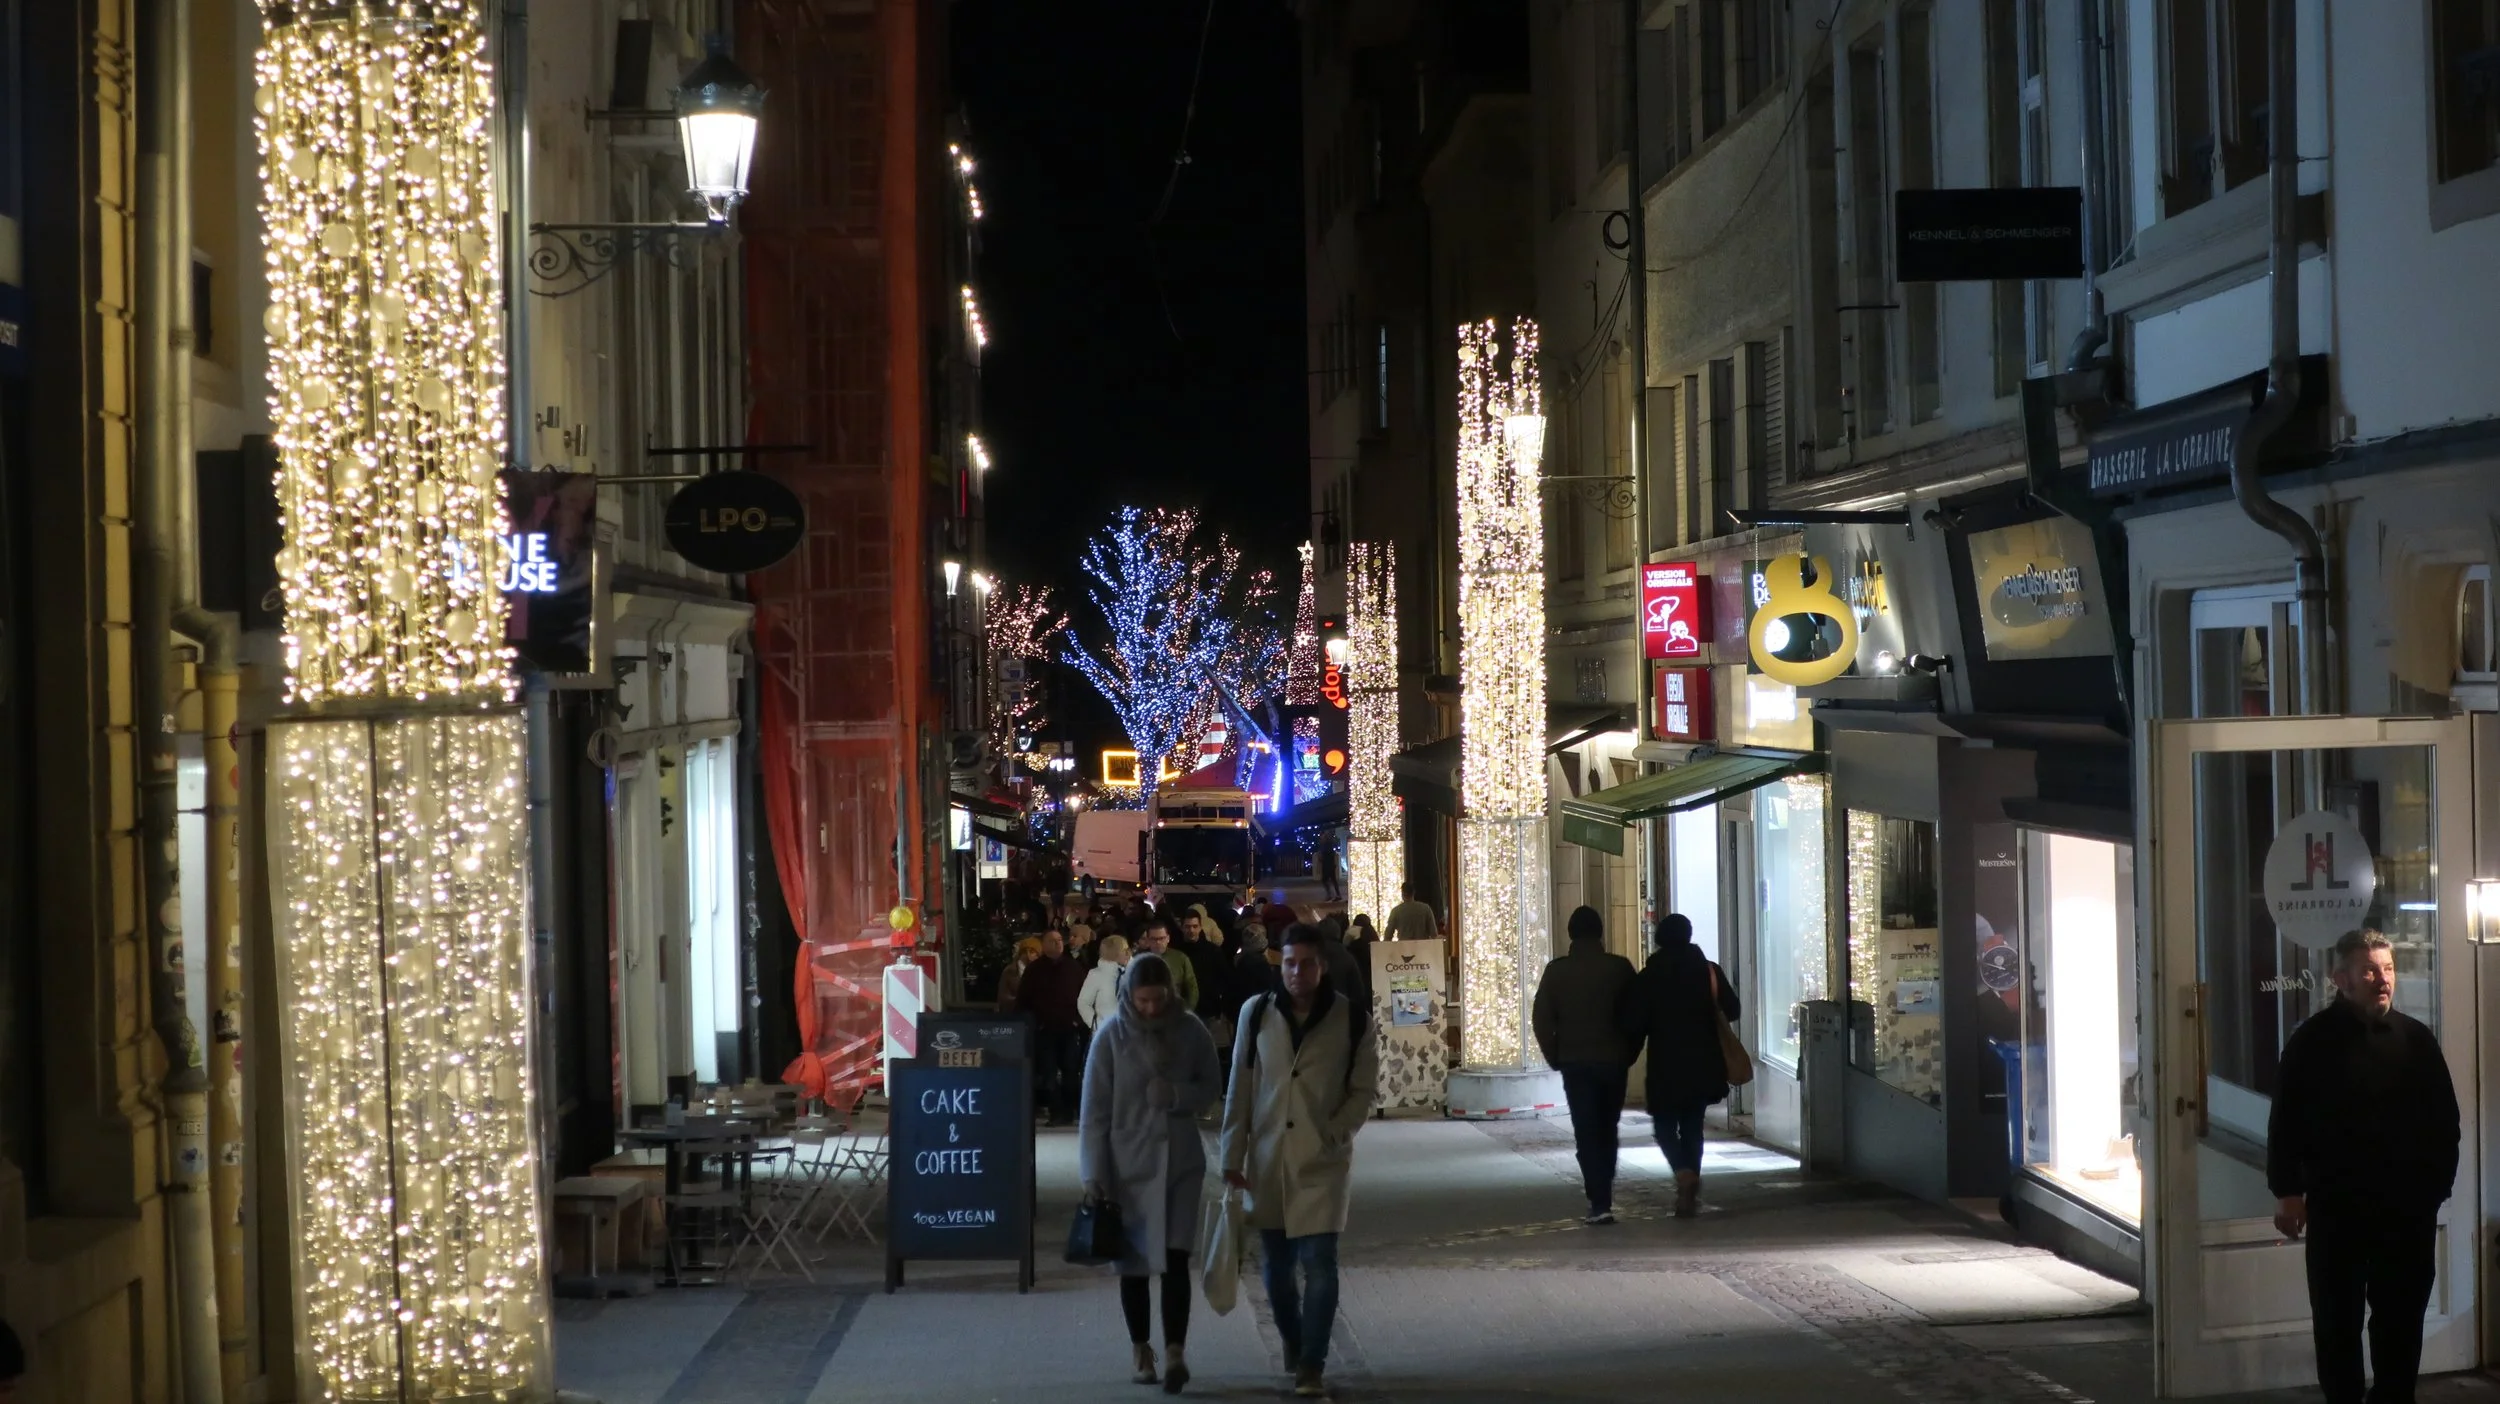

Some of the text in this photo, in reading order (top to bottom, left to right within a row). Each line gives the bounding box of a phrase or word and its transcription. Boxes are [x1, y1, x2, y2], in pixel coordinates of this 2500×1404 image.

[1908, 229, 1967, 242] KENNEL
[1983, 227, 2073, 240] SCHMENGER
[2156, 442, 2170, 475] LA
[2175, 426, 2231, 472] LORRAINE
[700, 507, 766, 532] LPO
[1646, 569, 1686, 580] VERSION
[1646, 577, 1693, 588] ORIGINALE
[942, 1051, 978, 1066] BEET
[921, 1088, 982, 1115] CAKE
[949, 1123, 959, 1143] &
[915, 1149, 983, 1175] COFFEE
[947, 1210, 996, 1223] VEGAN
